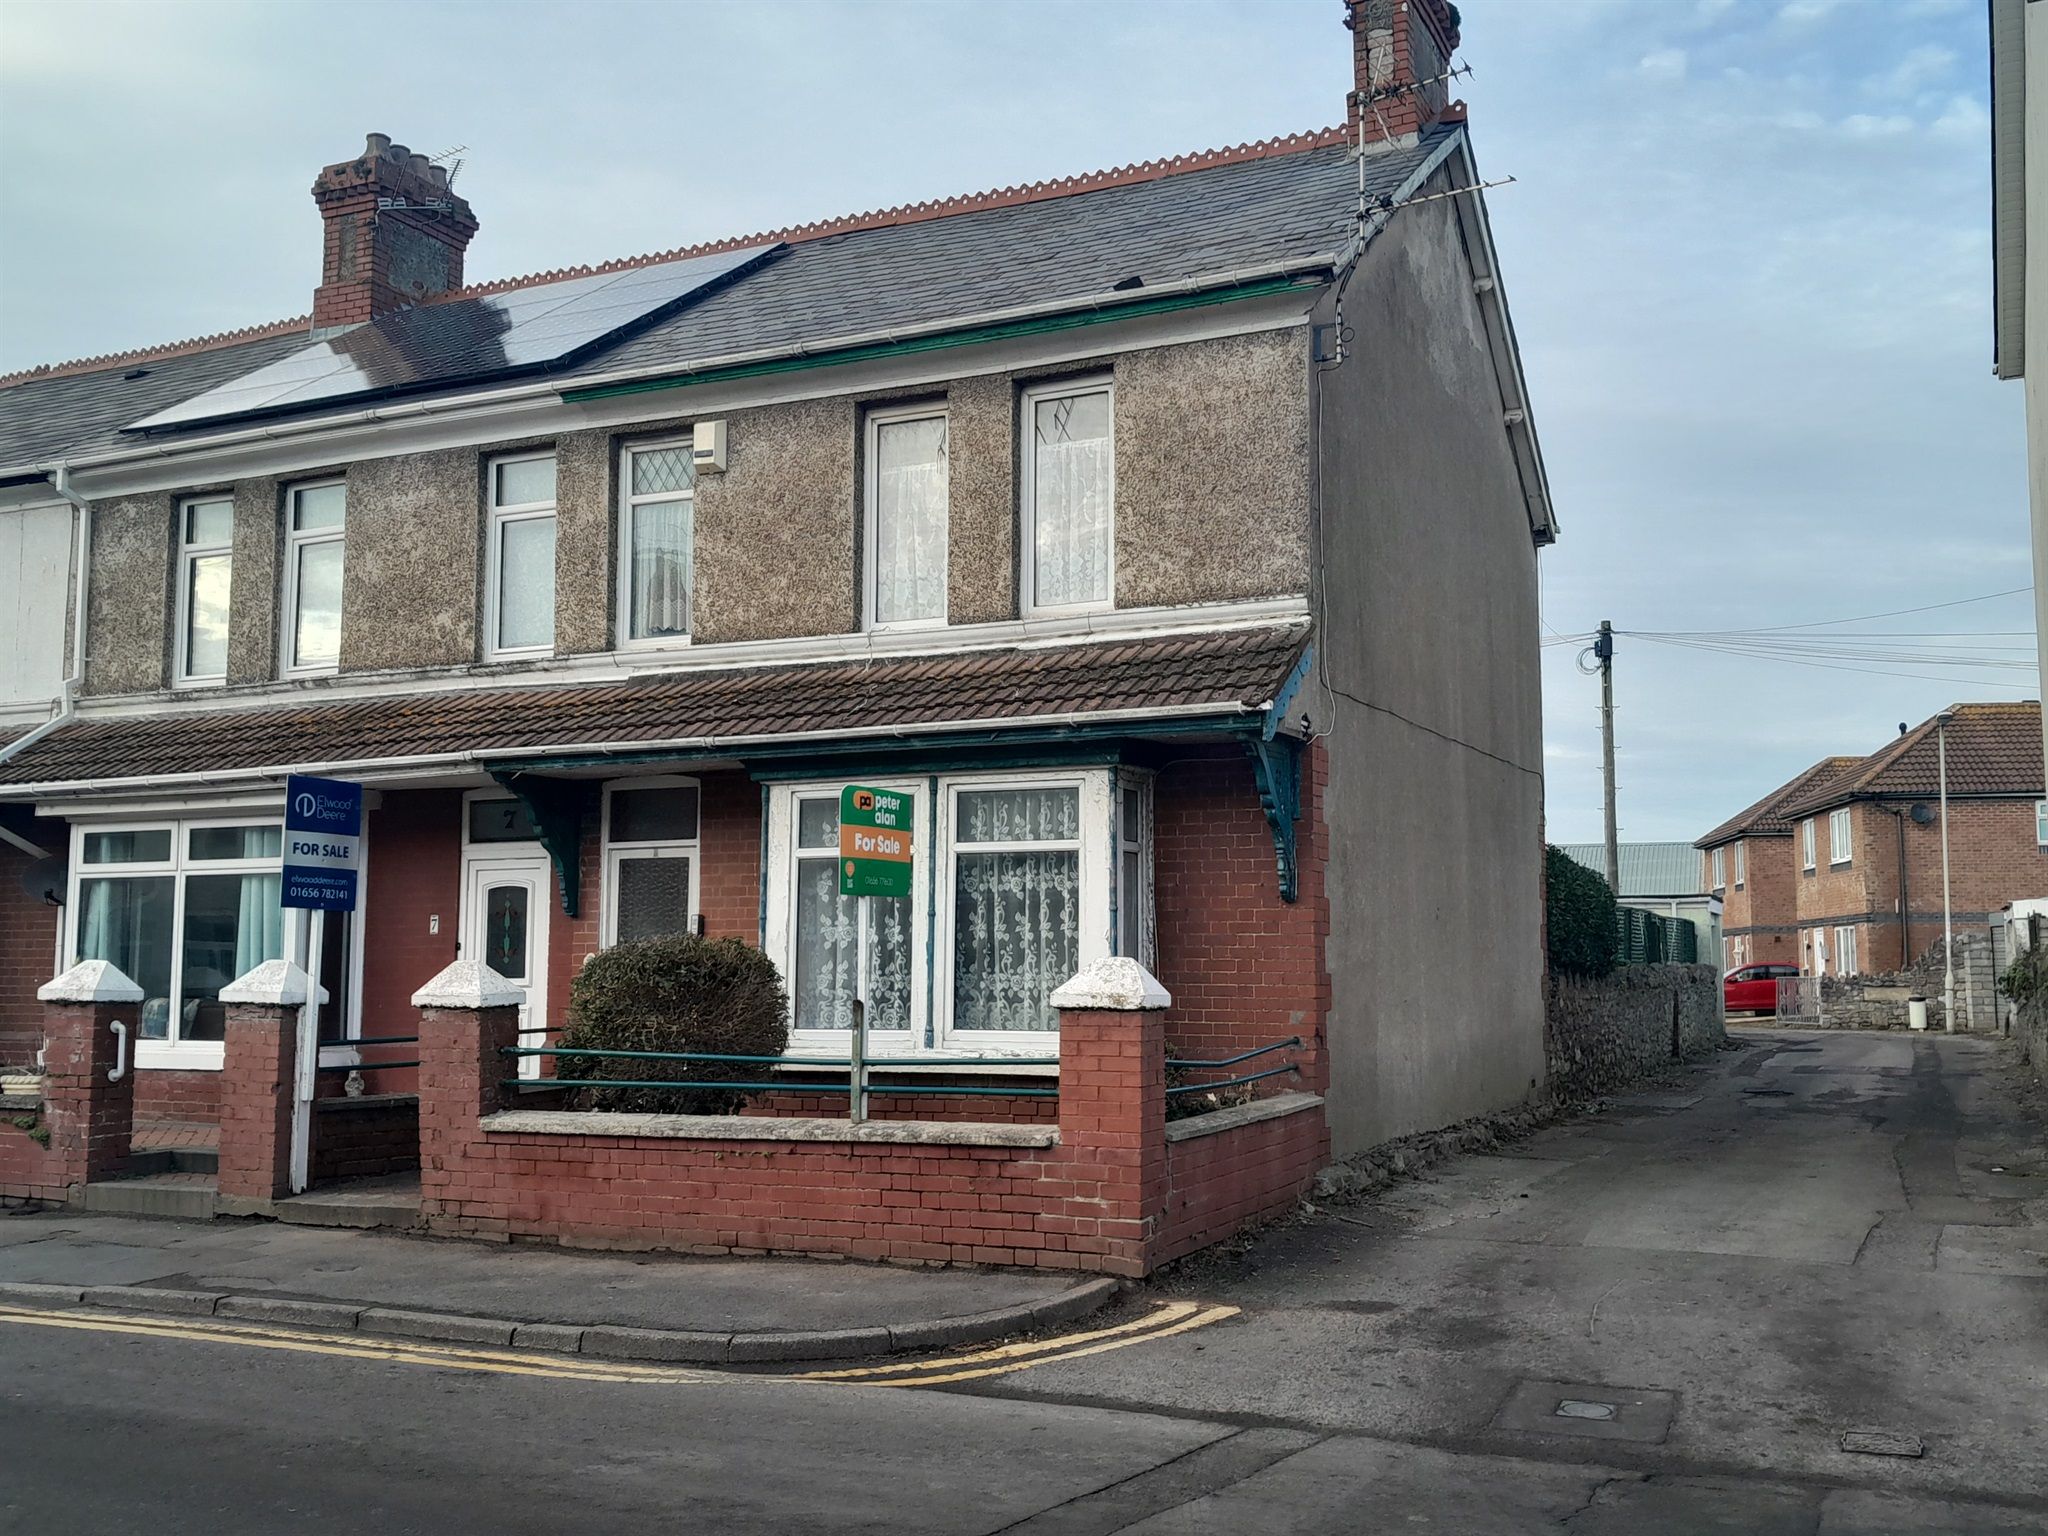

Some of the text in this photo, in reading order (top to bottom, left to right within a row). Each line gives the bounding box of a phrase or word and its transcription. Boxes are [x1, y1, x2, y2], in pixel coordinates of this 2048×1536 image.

[316, 795, 353, 810] Elwood
[875, 795, 901, 811] peter
[316, 807, 347, 821] Deere
[503, 809, 517, 829] 7
[874, 809, 896, 826] alan
[292, 842, 350, 859] FOR SALE
[855, 832, 900, 855] For Sale
[290, 886, 349, 900] 01656 782141
[430, 918, 438, 931] 7
